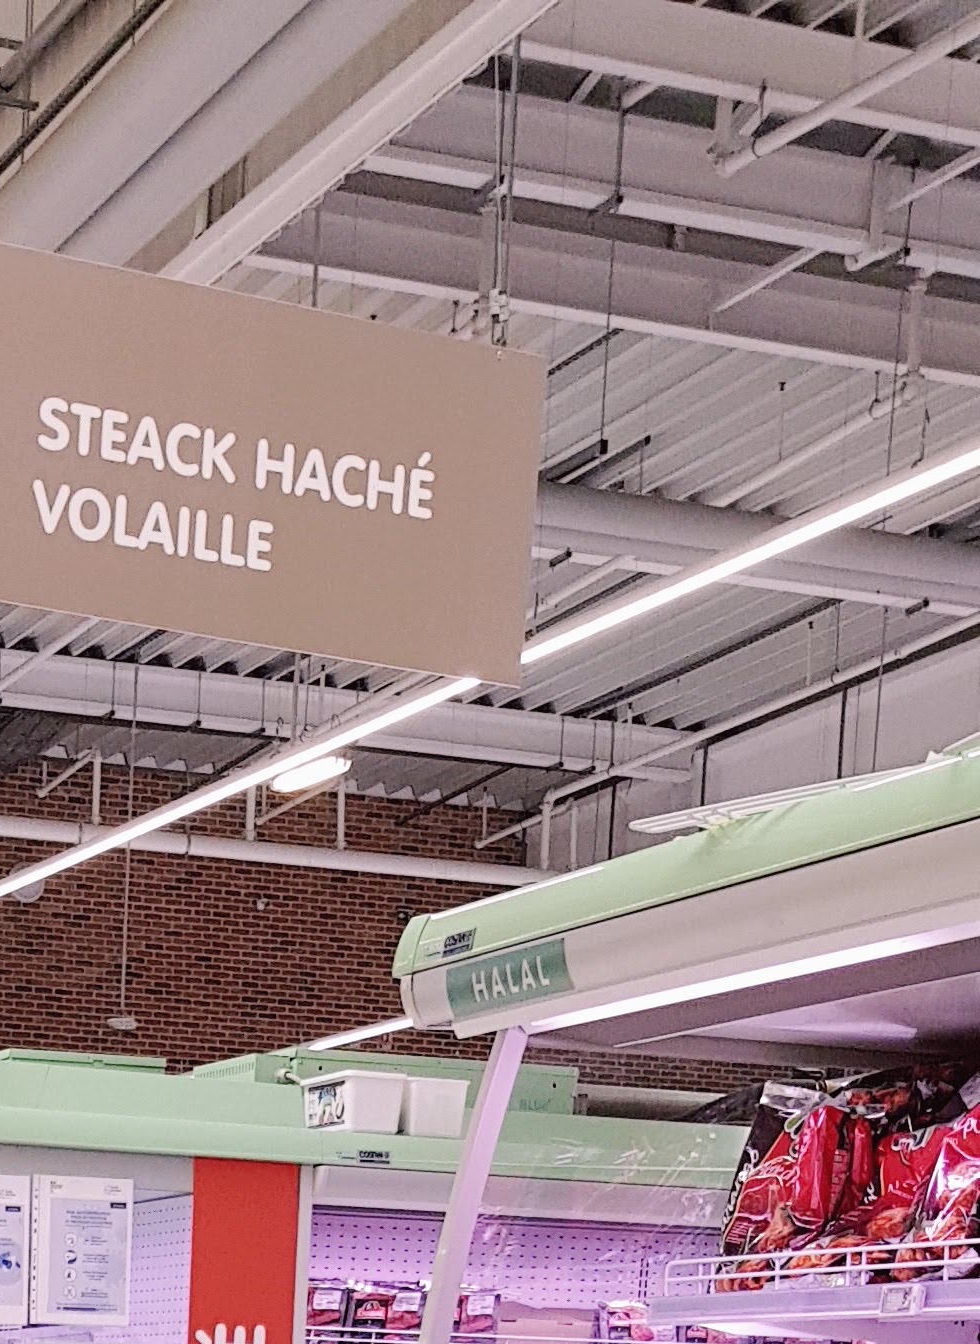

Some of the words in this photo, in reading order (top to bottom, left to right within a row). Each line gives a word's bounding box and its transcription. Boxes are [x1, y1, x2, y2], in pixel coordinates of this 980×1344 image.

[36, 396, 236, 484] STEACK
[256, 438, 436, 520] HACHÉ
[32, 479, 275, 573] VOLAILLE
[471, 955, 550, 1003] HALAL
